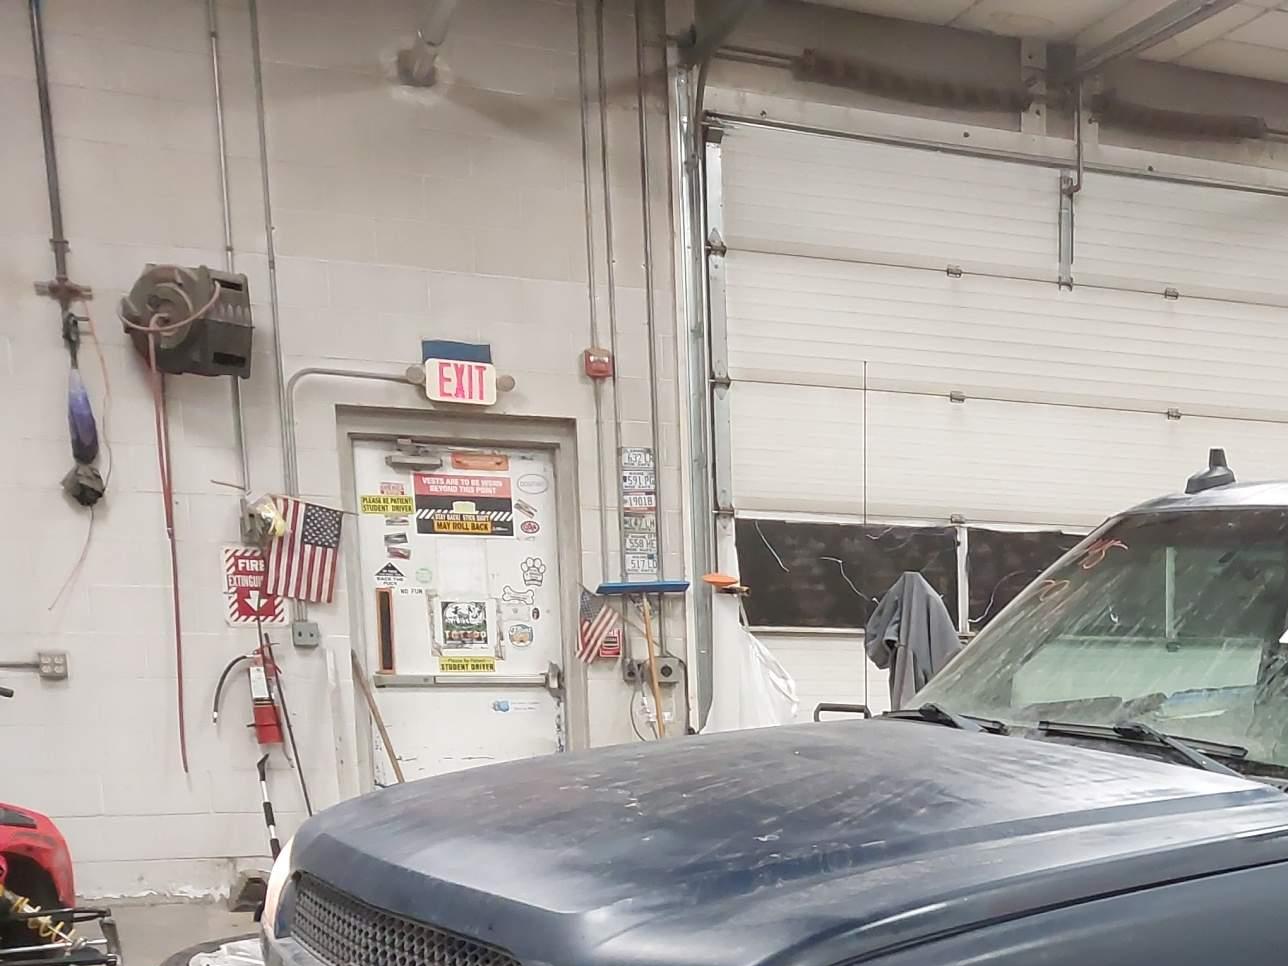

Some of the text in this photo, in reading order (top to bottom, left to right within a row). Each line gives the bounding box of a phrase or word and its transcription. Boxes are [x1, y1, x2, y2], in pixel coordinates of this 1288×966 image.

[438, 362, 487, 401] EXIT
[421, 476, 444, 485] VESTS
[445, 478, 459, 486] ARE
[460, 478, 470, 486] TO
[429, 485, 497, 495] BEYOND THIS POINT
[363, 504, 389, 512] STUDENT
[436, 522, 451, 530] MAY
[452, 522, 469, 531] ROLL
[470, 523, 489, 531] BACK
[237, 559, 265, 572] FIRE
[228, 574, 264, 587] EXTINGU
